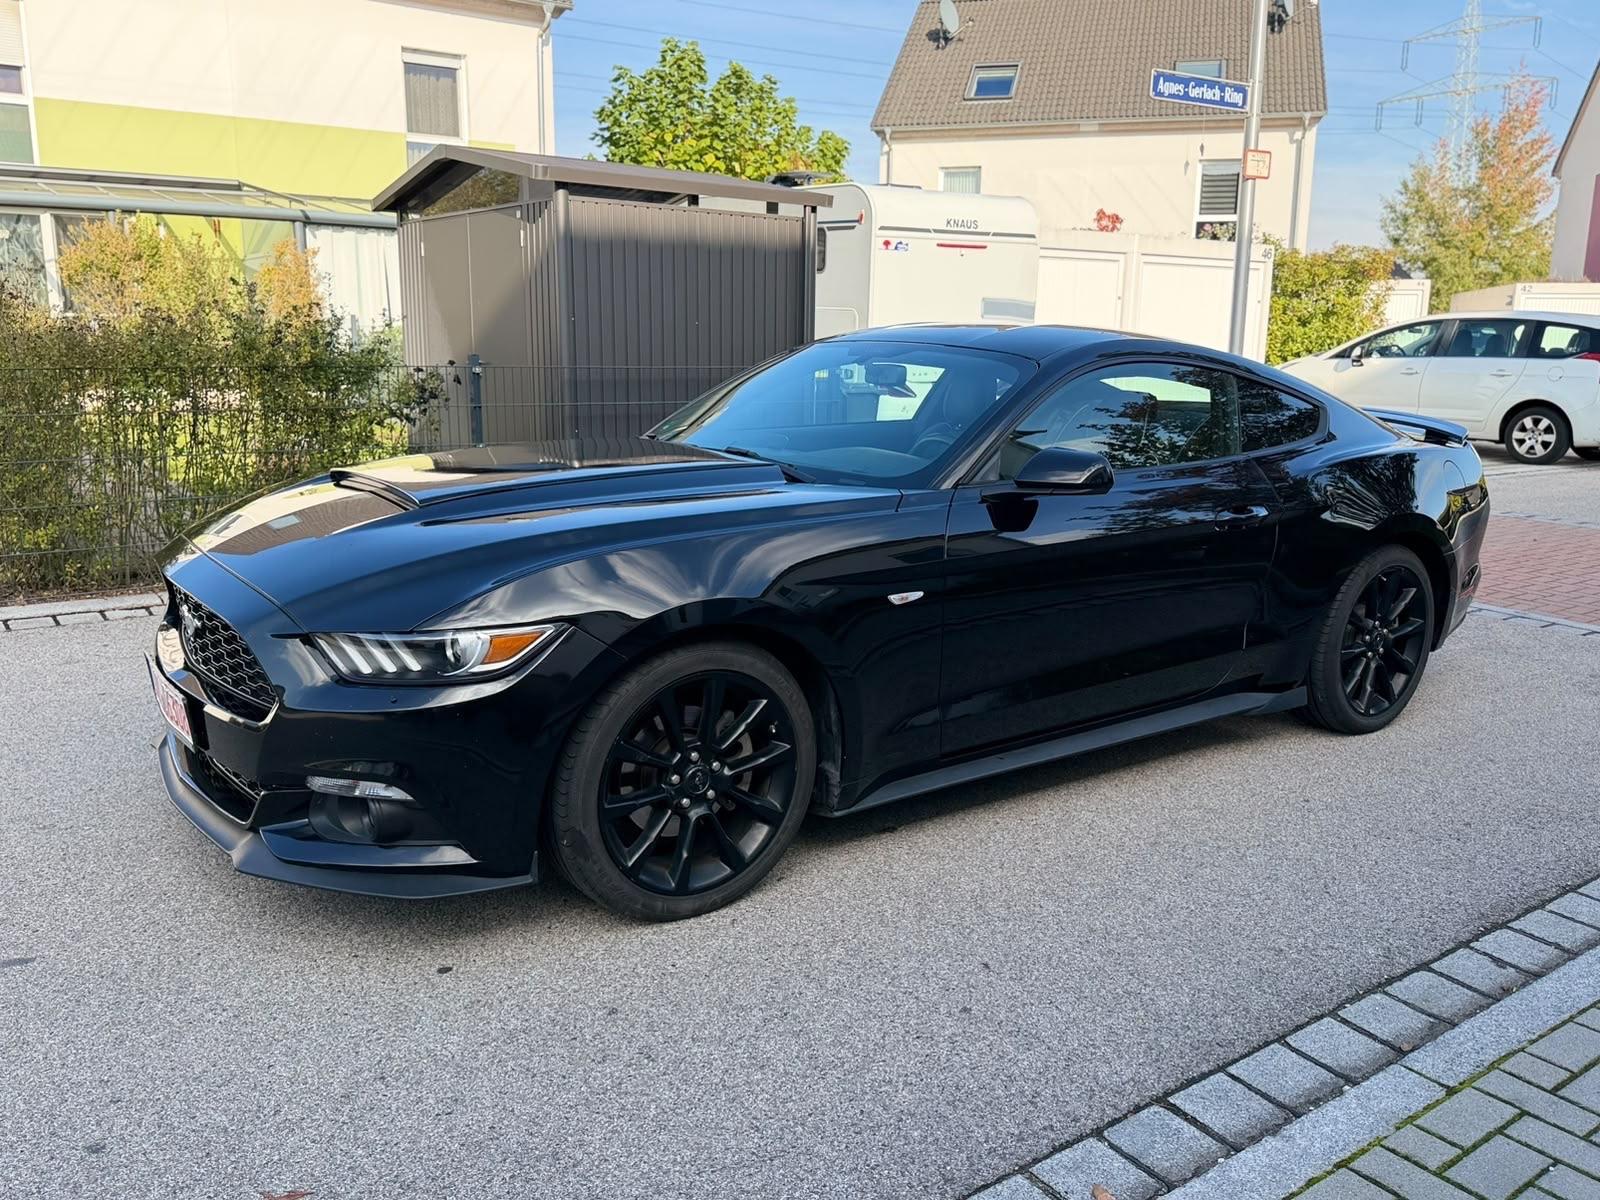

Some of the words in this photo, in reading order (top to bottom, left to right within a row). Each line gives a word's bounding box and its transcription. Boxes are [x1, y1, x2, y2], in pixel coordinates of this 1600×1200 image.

[1157, 76, 1243, 106] Agnes-Gerlach-Ring
[945, 218, 979, 230] KNAUS
[1261, 247, 1273, 260] 46
[1520, 284, 1533, 293] 42
